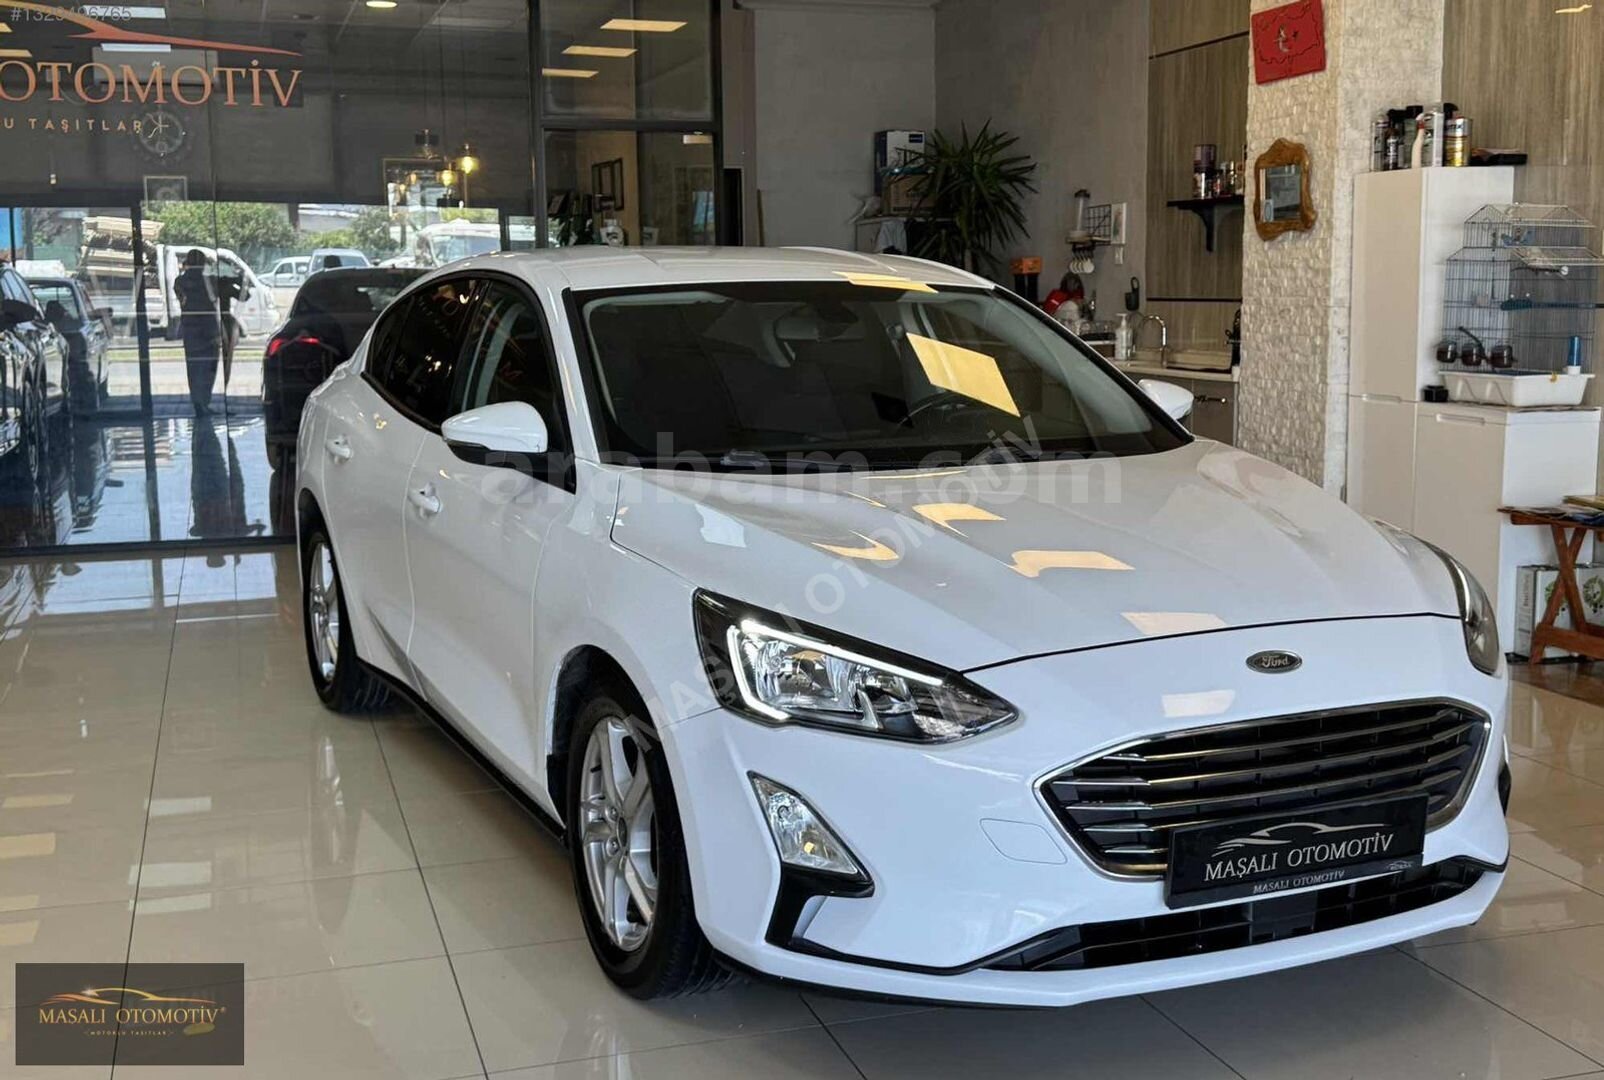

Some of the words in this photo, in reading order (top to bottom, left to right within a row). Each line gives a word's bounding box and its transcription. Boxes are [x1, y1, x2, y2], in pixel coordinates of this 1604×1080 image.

[0, 59, 302, 107] OTOMOTİV
[28, 118, 142, 133] TAŞITLAR
[1262, 655, 1289, 668] Ford
[1204, 852, 1278, 882] MAŞALI
[1287, 831, 1394, 867] OTOMOTİV
